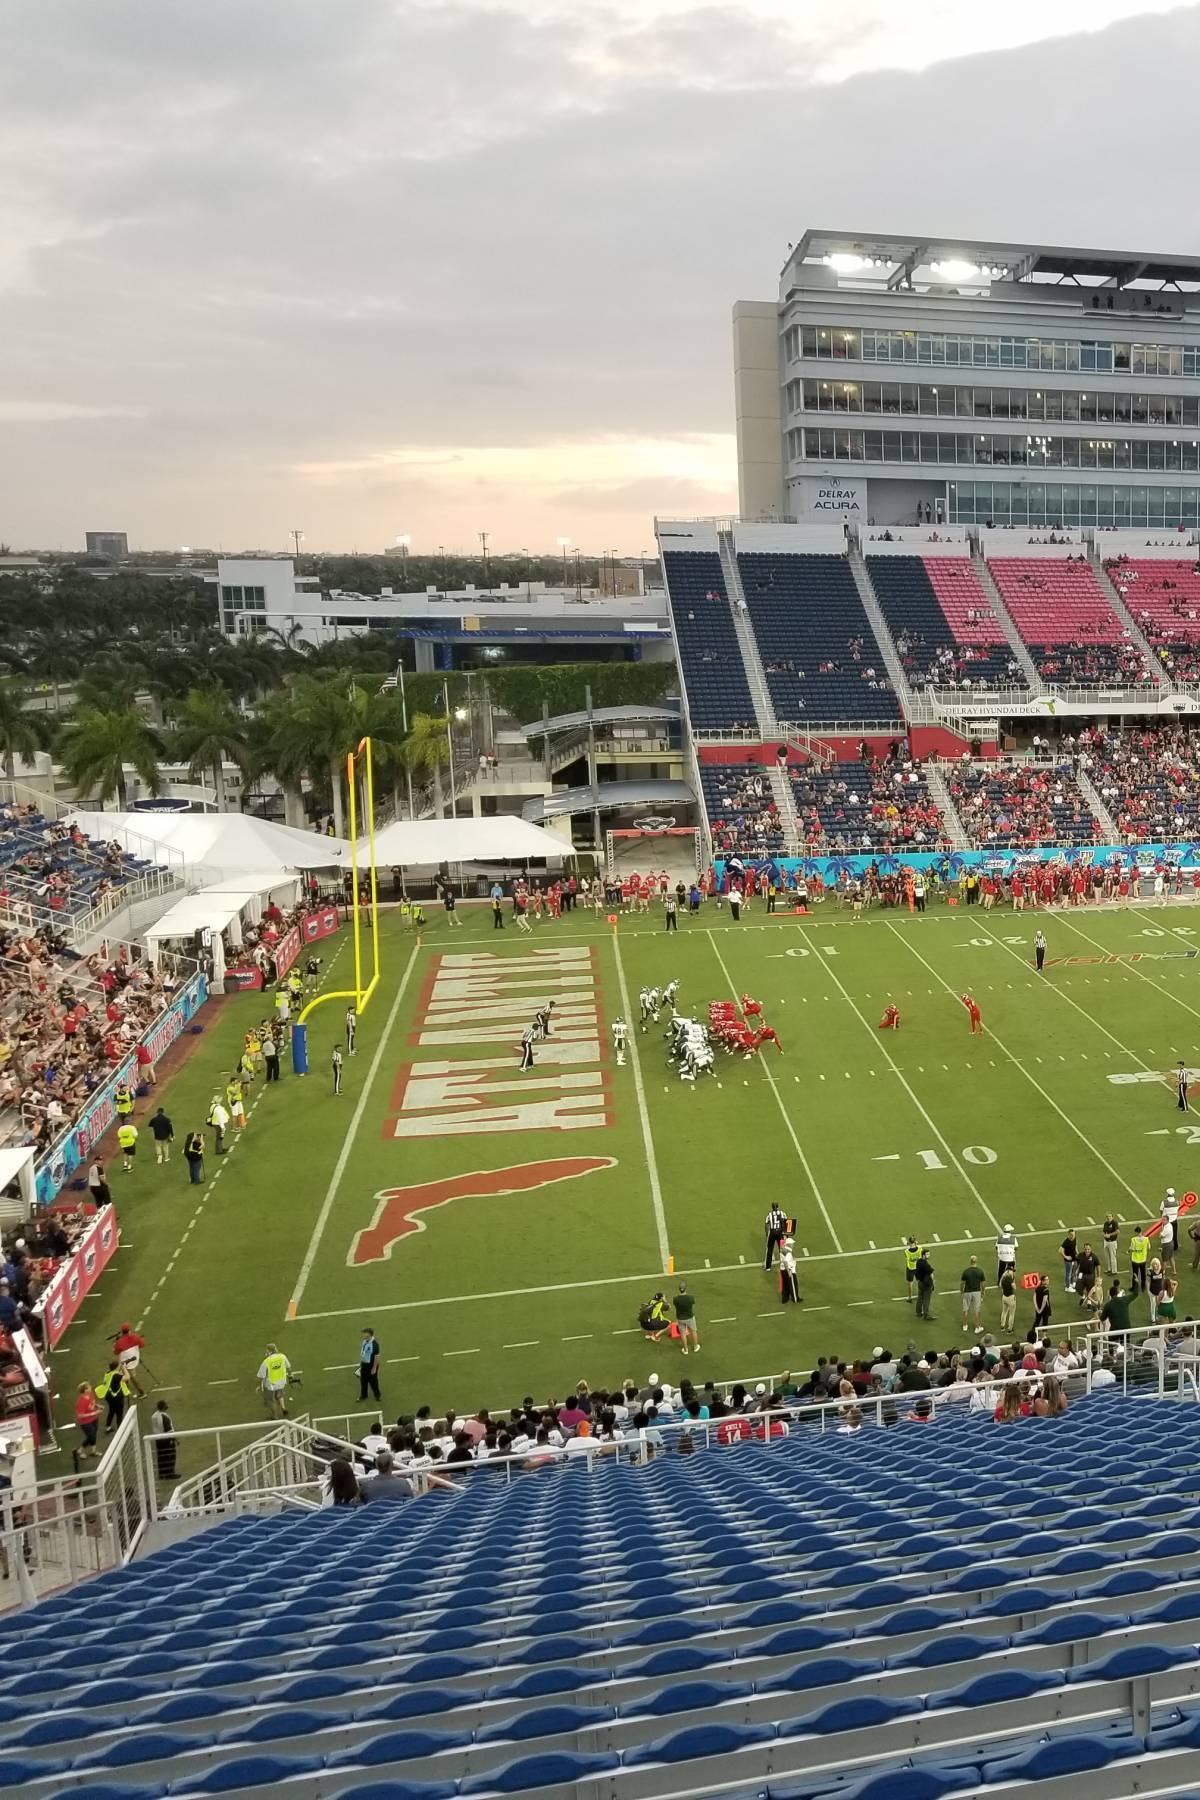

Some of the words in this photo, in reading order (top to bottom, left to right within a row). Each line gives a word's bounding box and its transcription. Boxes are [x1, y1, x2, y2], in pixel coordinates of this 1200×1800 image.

[818, 489, 857, 499] DELRAY
[814, 501, 861, 510] ACURA
[945, 706, 980, 716] DELRAY
[979, 706, 1019, 715] HYUNDAI
[1019, 705, 1041, 714] DECK
[1141, 927, 1197, 938] 30
[969, 936, 1029, 947] 20
[785, 946, 841, 957] 10
[915, 1145, 998, 1170] 10
[1026, 1275, 1038, 1287] 10
[726, 1429, 742, 1444] 14
